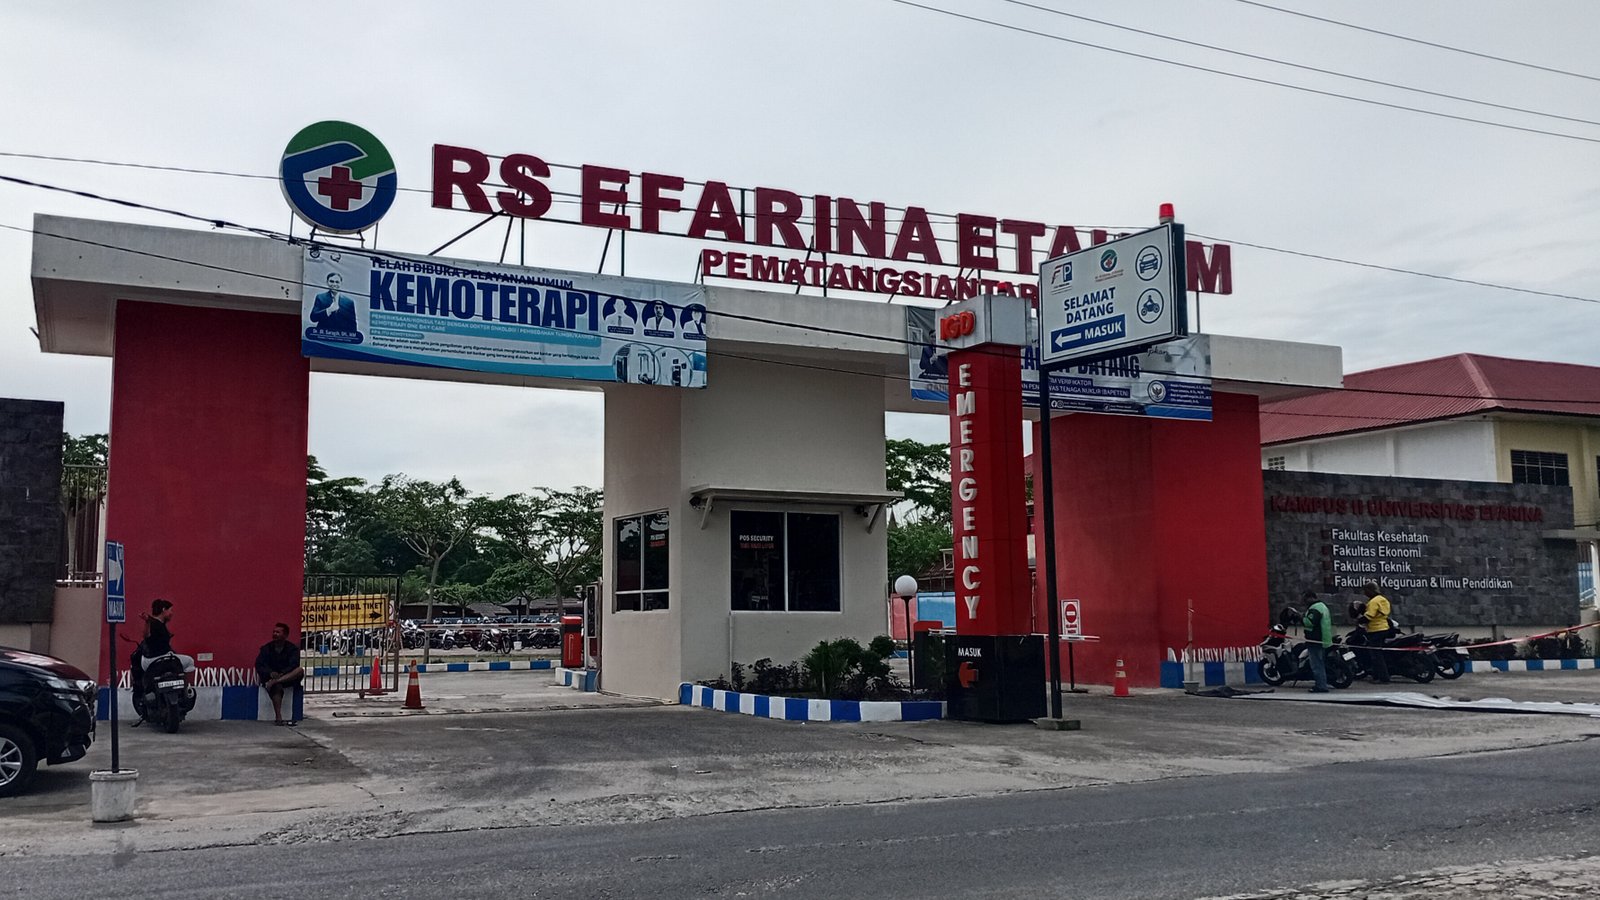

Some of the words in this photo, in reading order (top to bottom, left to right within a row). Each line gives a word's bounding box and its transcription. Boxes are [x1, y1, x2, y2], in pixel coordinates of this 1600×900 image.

[432, 144, 552, 218] RS
[581, 164, 942, 264] EFARINA
[957, 213, 1232, 294] ETAM
[371, 258, 410, 272] TELAH
[414, 264, 460, 279] DIBUKA
[539, 277, 573, 289] UMUM
[370, 270, 598, 331] KEMOTERAPI
[1064, 287, 1116, 311] SELAMAT
[1066, 302, 1114, 324] DATANG
[940, 311, 976, 341] IGD
[1084, 321, 1122, 339] MASUK
[956, 363, 981, 620] EMERGENCY
[1271, 496, 1347, 514] KAMPUS
[1367, 500, 1475, 520] UNIVERSITAS
[1480, 505, 1544, 522] EFARINA
[1332, 528, 1375, 542] Fakultas
[1377, 530, 1429, 543] Kesehatan
[1333, 545, 1376, 557] Fakultas
[1378, 546, 1421, 558] Ekonomi
[1333, 560, 1377, 572] Fakultas
[1379, 561, 1411, 573] Teknik
[1380, 576, 1428, 590] Keguruan
[1430, 577, 1438, 588] &
[1439, 577, 1461, 589] Ilmu
[1463, 577, 1513, 589] Pendidikan
[363, 602, 382, 610] TIKET
[958, 647, 982, 657] MASUK
